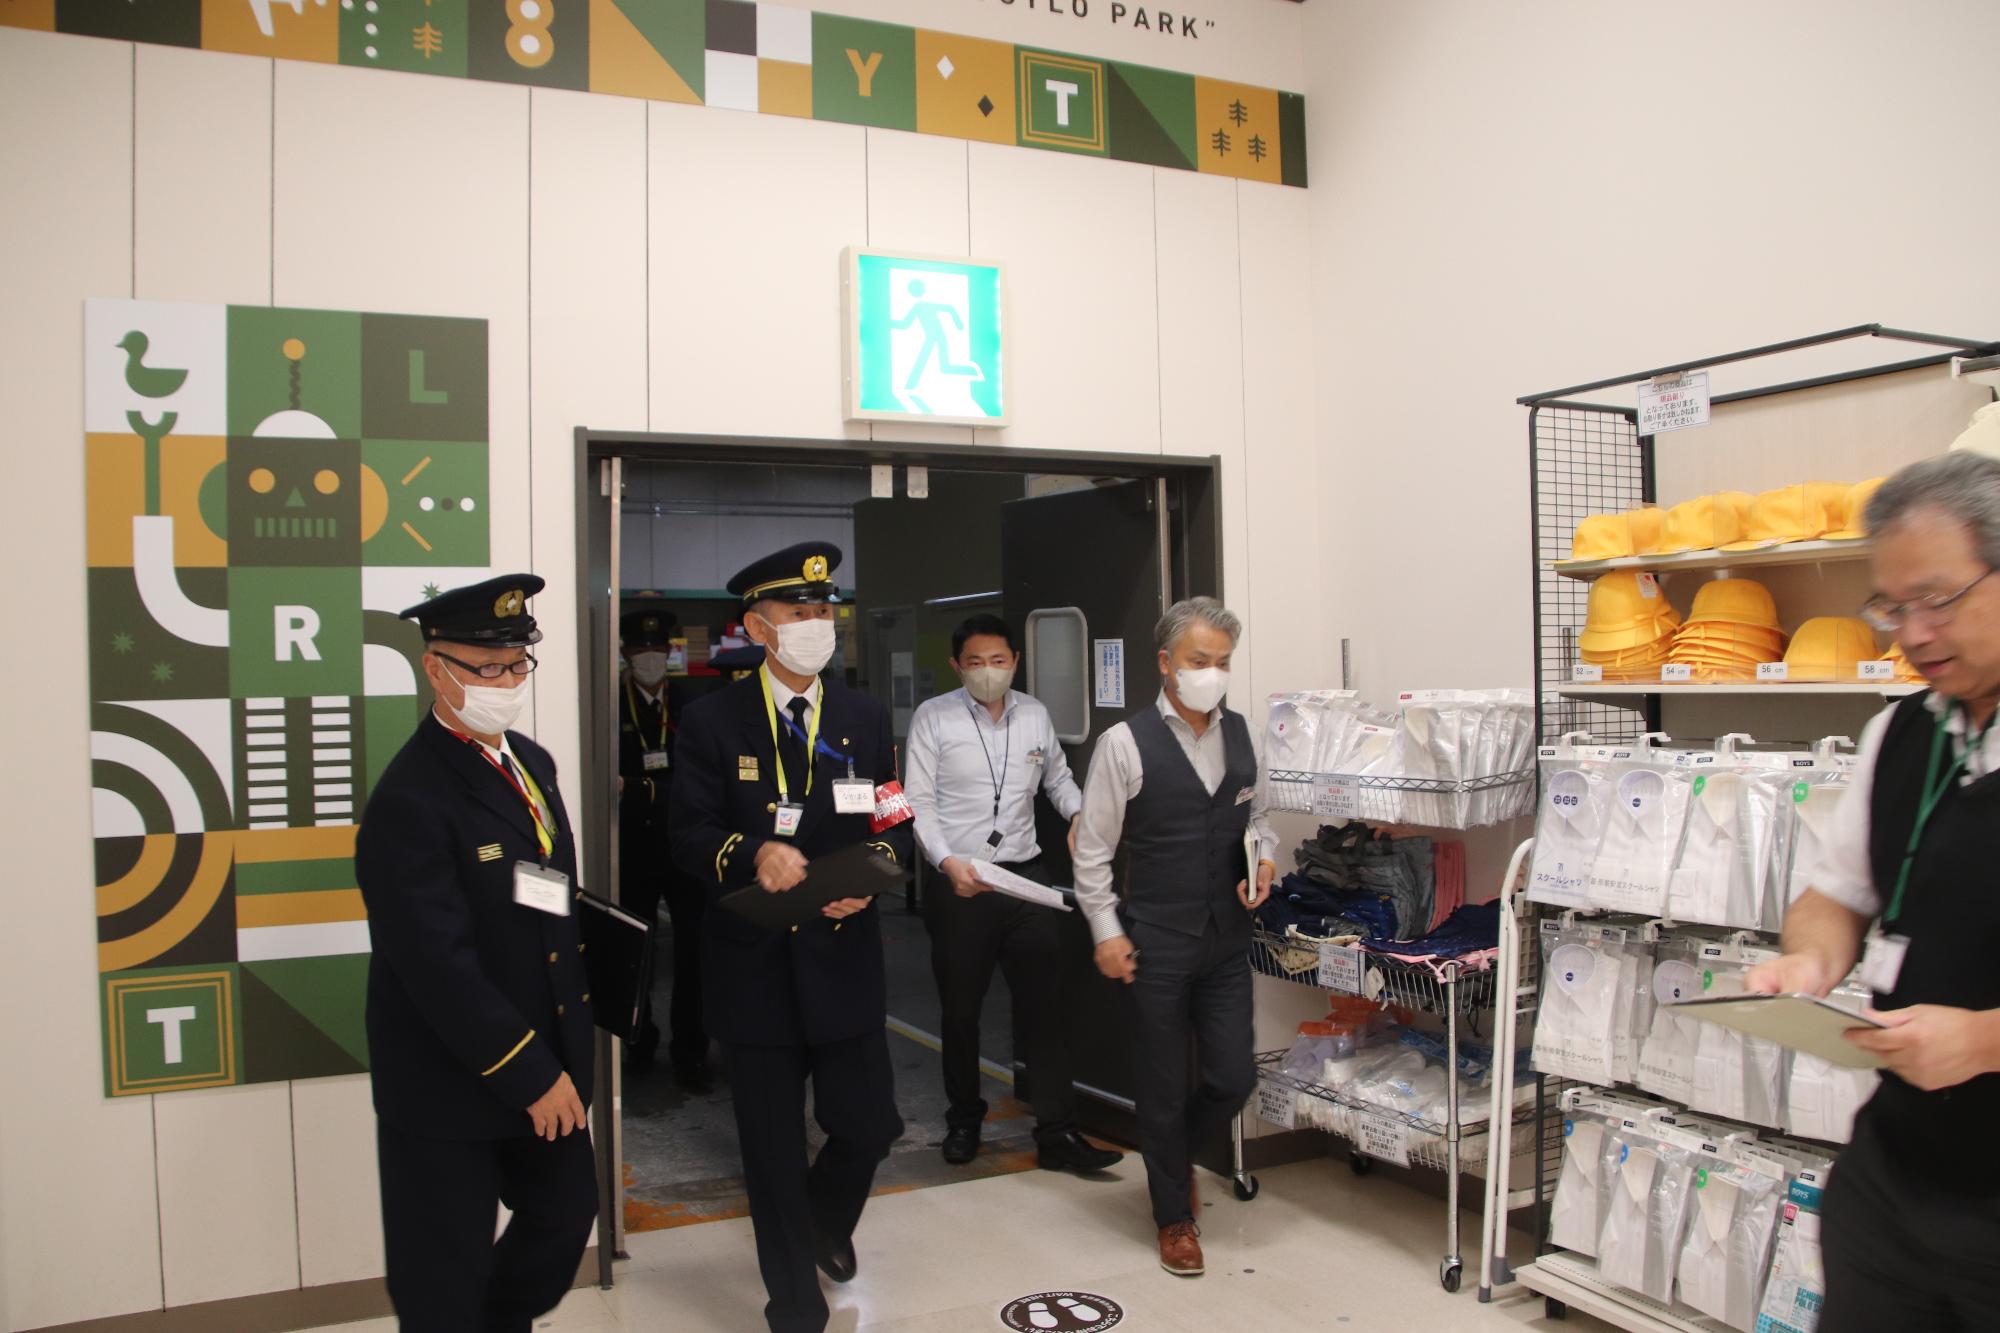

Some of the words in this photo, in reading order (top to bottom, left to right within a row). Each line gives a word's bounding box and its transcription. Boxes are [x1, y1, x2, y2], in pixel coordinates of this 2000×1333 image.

[1111, 2, 1215, 39] PARK"
[845, 48, 884, 98] Y
[1045, 78, 1079, 126] T
[409, 349, 448, 404] L
[273, 604, 322, 662] R
[1576, 667, 1584, 675] 52
[1762, 665, 1771, 673] 56
[1865, 665, 1875, 673] 58
[1537, 873, 1582, 886] スクールシャツ
[146, 1005, 196, 1064] T
